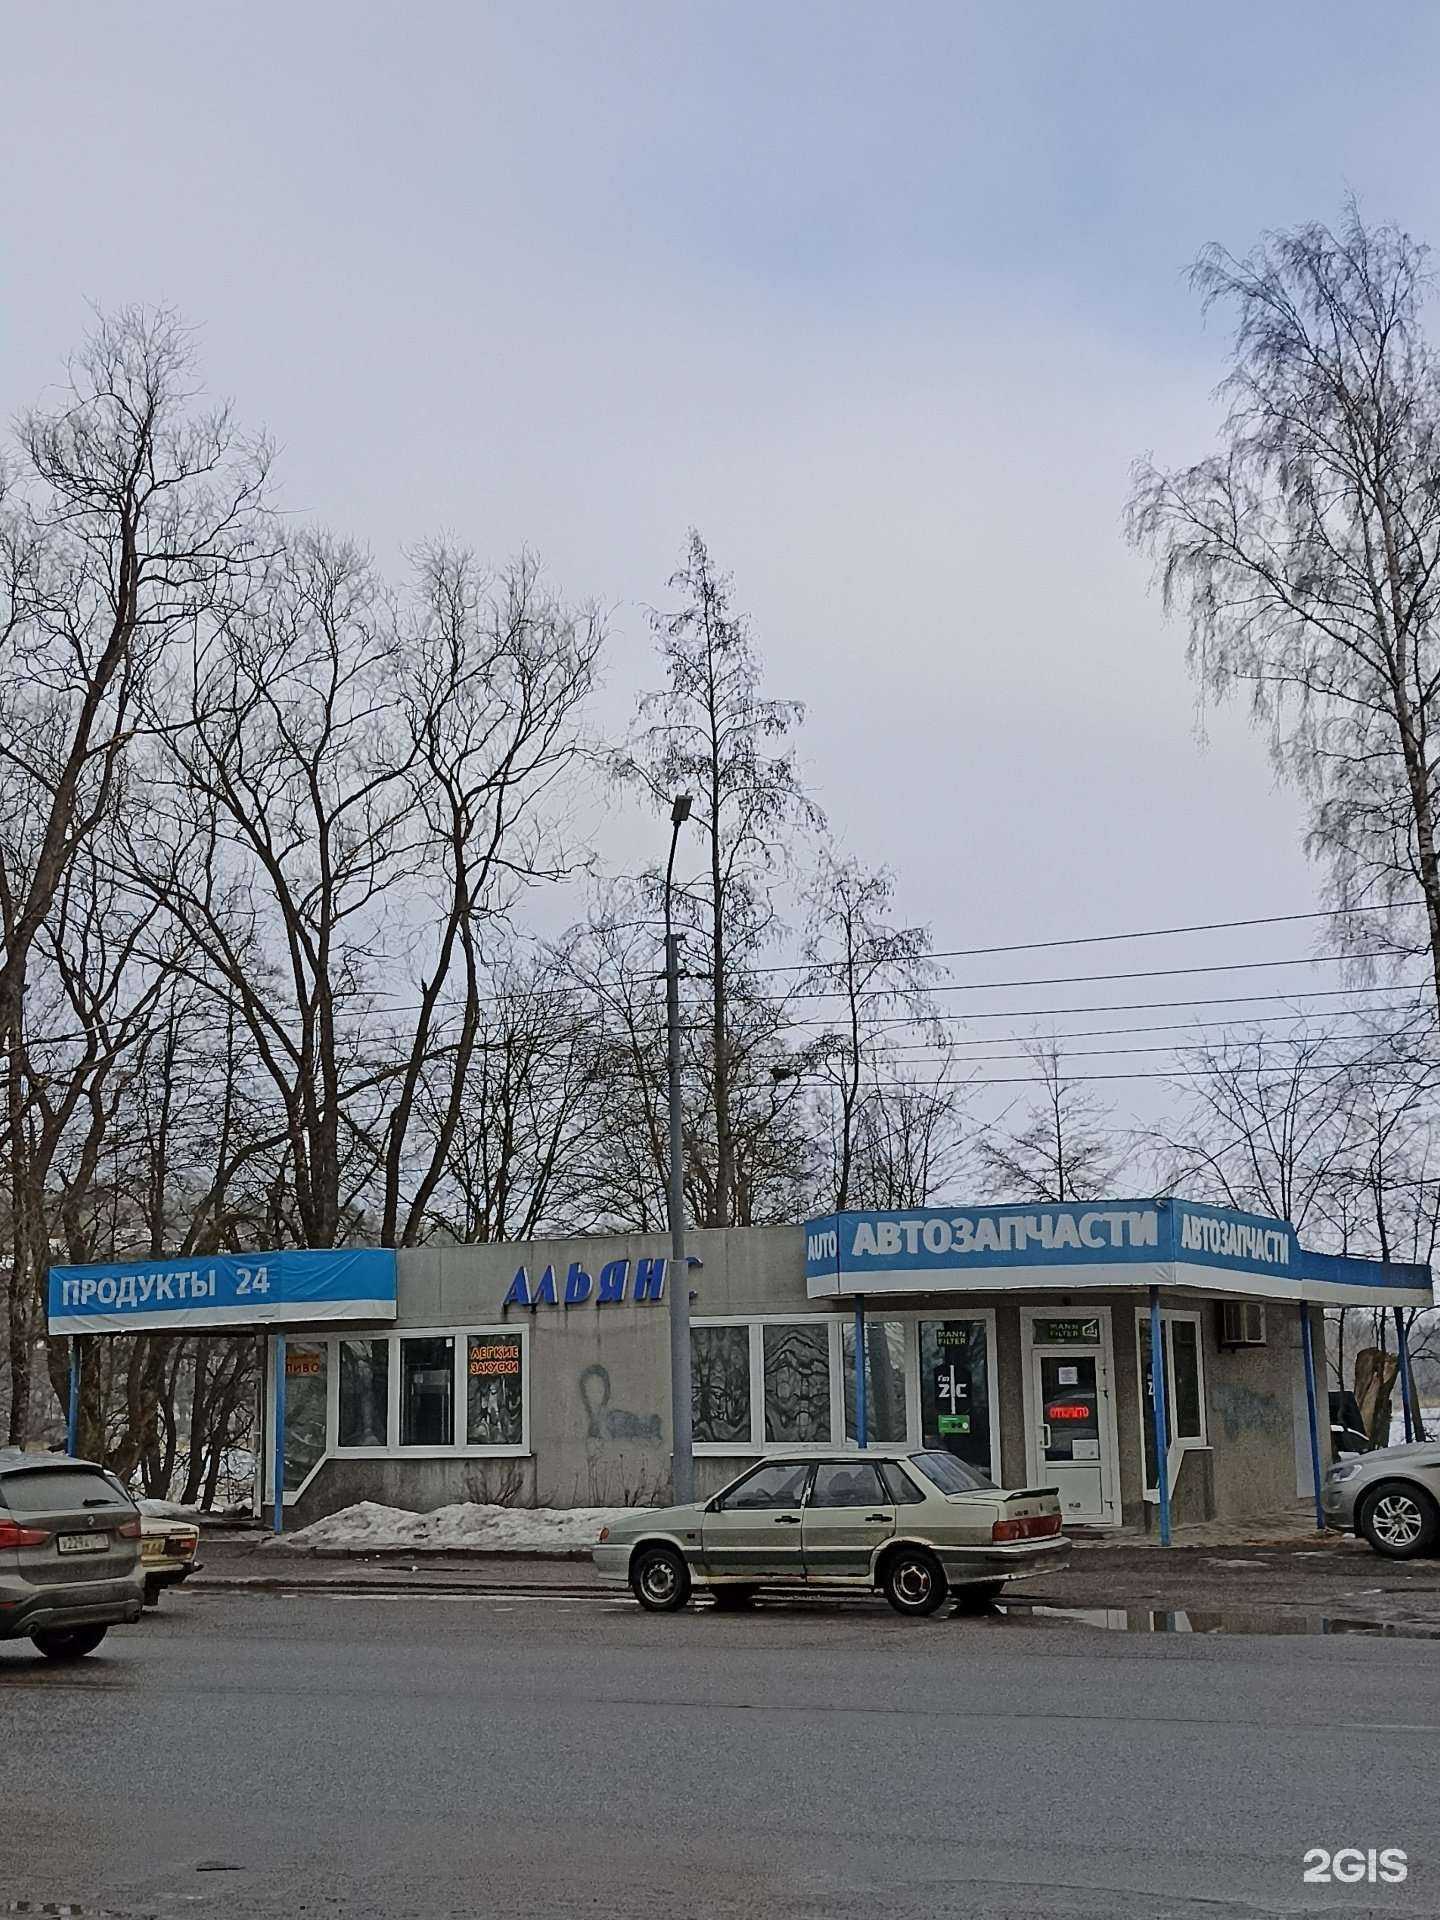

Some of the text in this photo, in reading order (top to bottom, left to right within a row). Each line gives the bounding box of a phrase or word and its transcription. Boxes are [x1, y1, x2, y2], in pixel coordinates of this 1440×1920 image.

[808, 1230, 837, 1261] AUTO
[851, 1211, 1159, 1257] АВТОЗАПЧАСТИ
[1181, 1213, 1289, 1265] АВТОЗАПЧАСТИ
[62, 1267, 270, 1308] ПРОДУКТЫ 24
[503, 1256, 704, 1305] АЛЬЯН
[471, 1345, 519, 1359] ЛЕГКИЕ
[938, 1330, 966, 1338] MANN
[471, 1361, 519, 1375] ЗАКУСКИ
